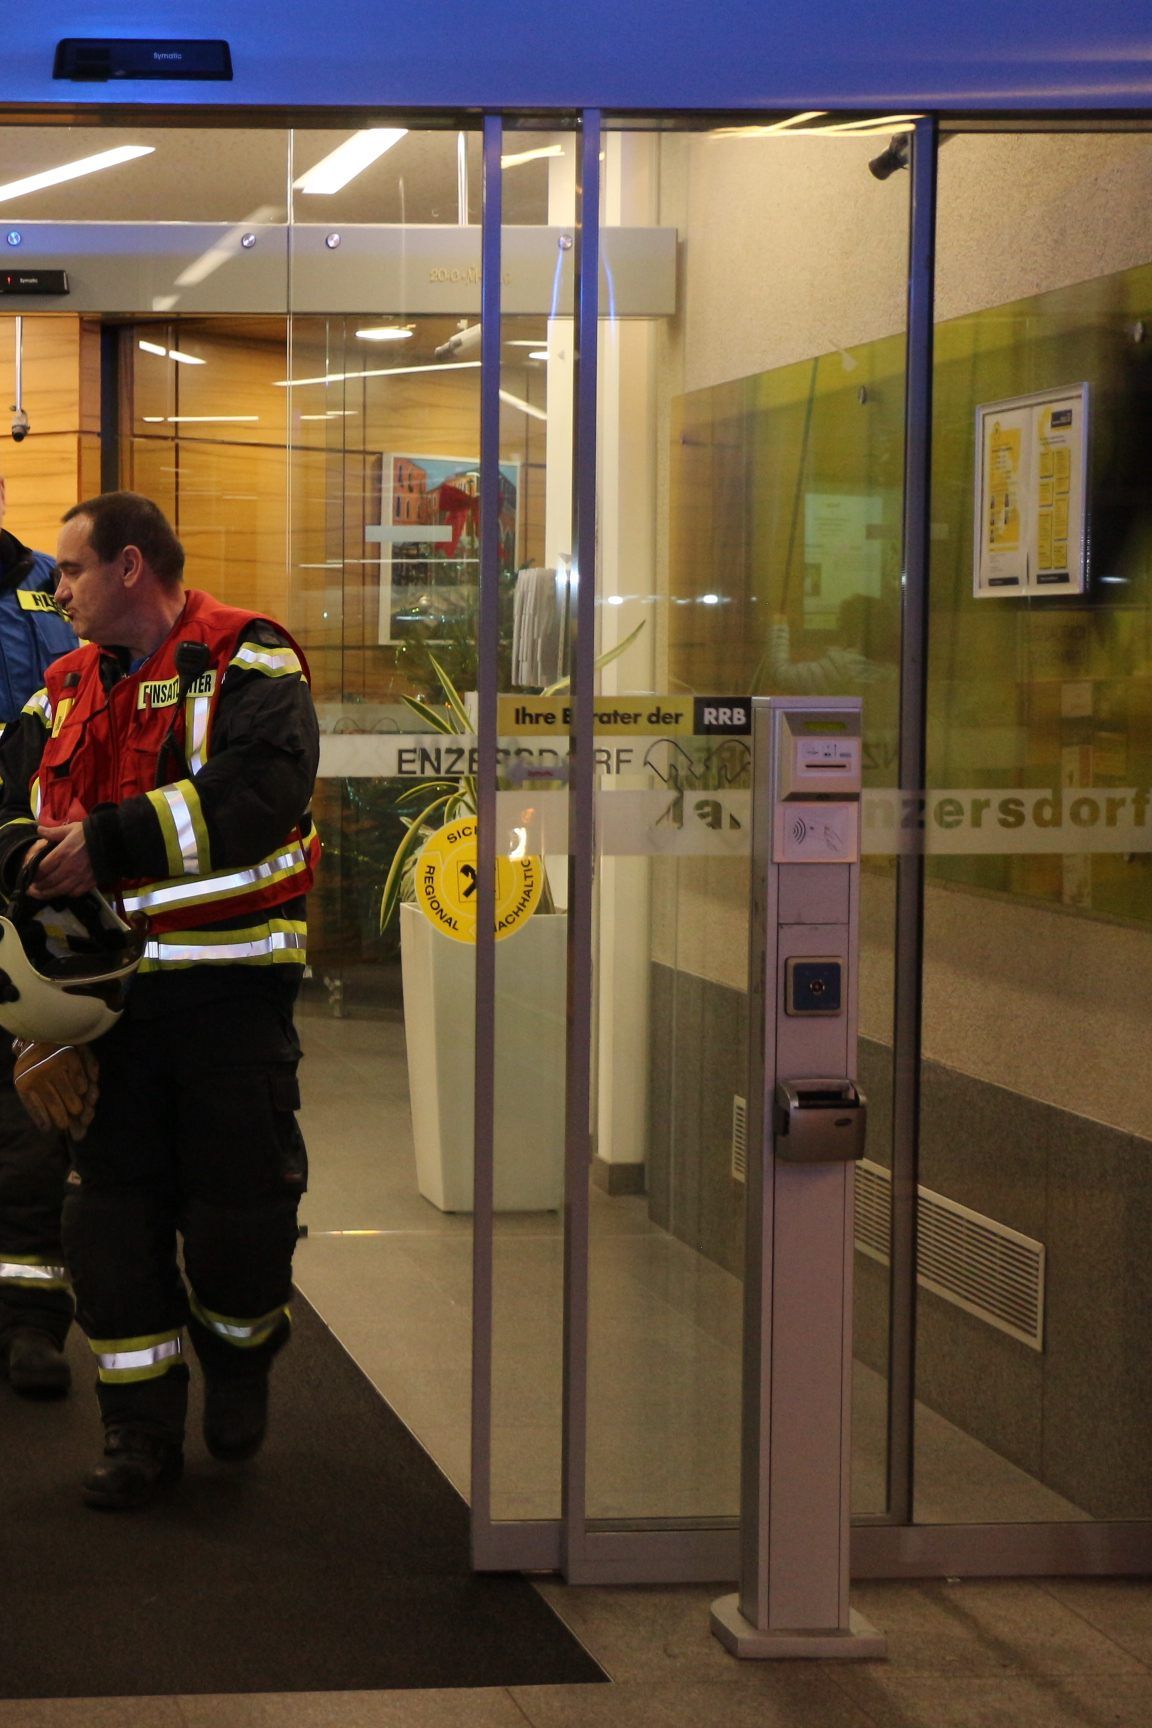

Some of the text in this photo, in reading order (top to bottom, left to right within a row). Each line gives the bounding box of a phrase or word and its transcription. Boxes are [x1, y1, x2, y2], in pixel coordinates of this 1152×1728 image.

[515, 706, 683, 725] Ihre Brater der
[703, 707, 746, 726] RRB
[862, 786, 1152, 829] nzersdorf
[424, 865, 459, 931] REGIONAL
